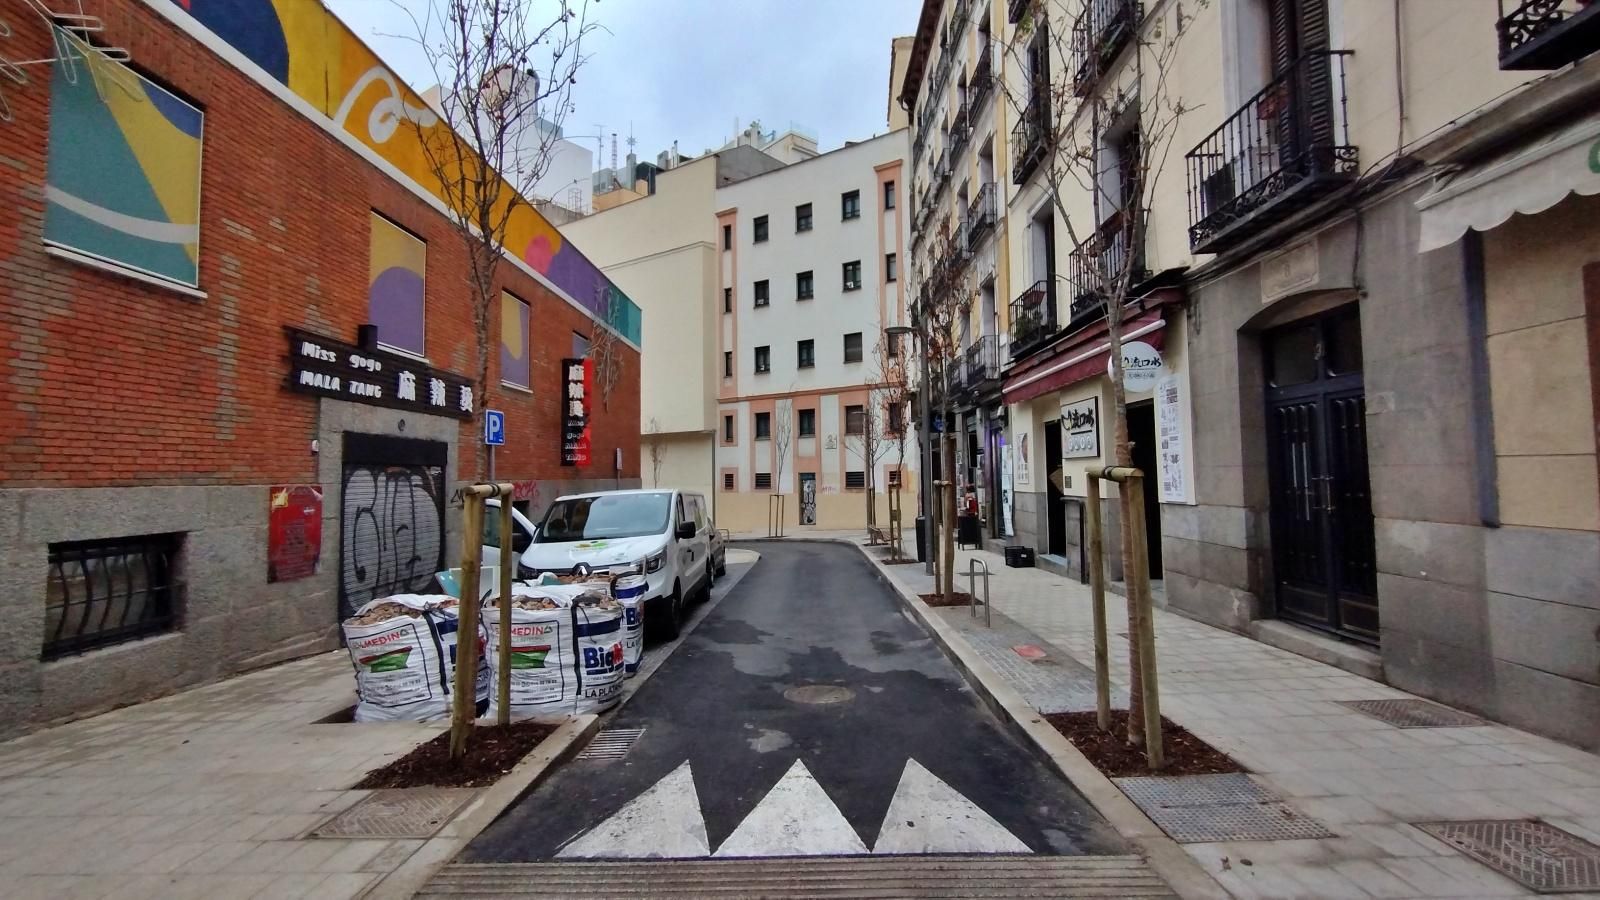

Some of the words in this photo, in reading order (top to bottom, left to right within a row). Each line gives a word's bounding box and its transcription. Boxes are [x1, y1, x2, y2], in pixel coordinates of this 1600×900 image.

[301, 341, 337, 362] Miss
[349, 354, 382, 372] gogo
[300, 370, 341, 391] MALA
[349, 380, 382, 399] TANG
[489, 414, 500, 441] P
